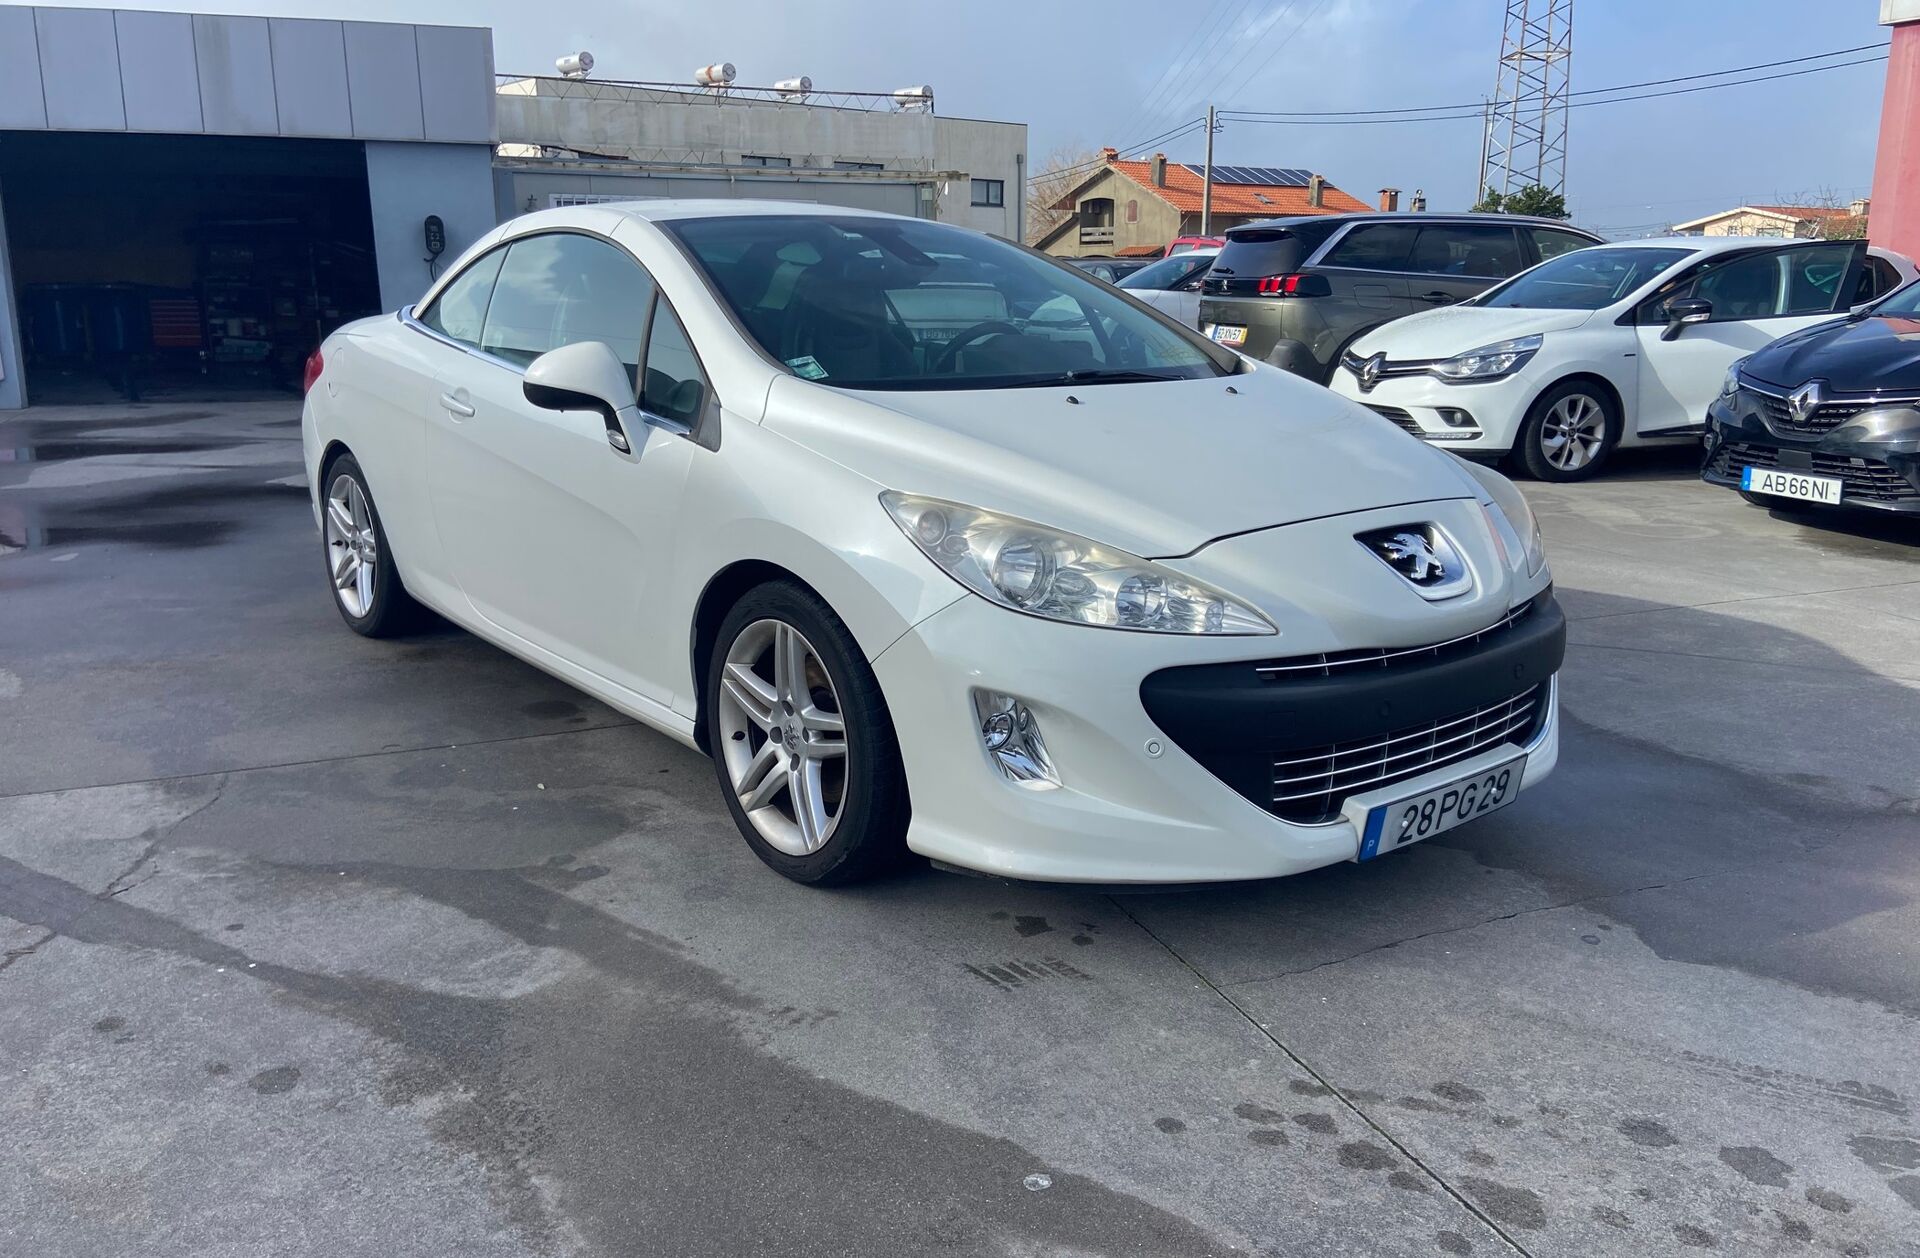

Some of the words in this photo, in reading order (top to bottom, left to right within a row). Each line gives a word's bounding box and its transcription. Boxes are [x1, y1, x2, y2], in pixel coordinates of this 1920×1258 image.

[1761, 473, 1830, 500] AB66NI
[1396, 768, 1511, 845] 28PG29
[1367, 839, 1375, 851] P
